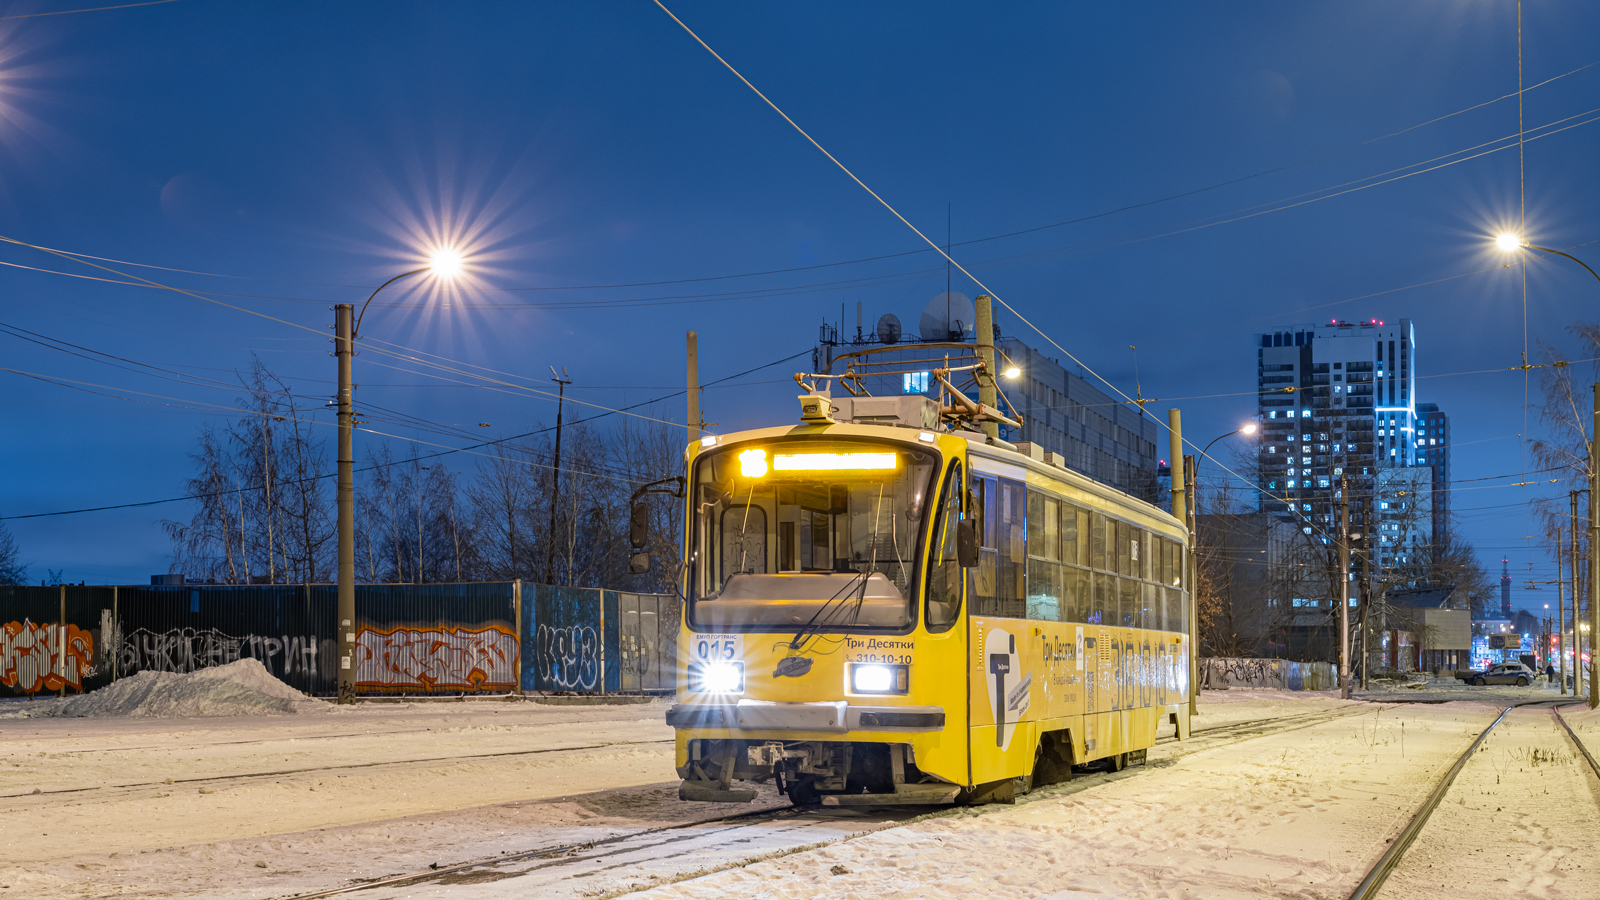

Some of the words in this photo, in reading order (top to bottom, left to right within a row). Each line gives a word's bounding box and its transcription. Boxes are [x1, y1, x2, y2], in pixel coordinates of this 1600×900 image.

[697, 640, 735, 660] 015
[846, 638, 864, 649] Три
[867, 638, 914, 650] Десятки
[856, 653, 912, 664] 310-10-10
